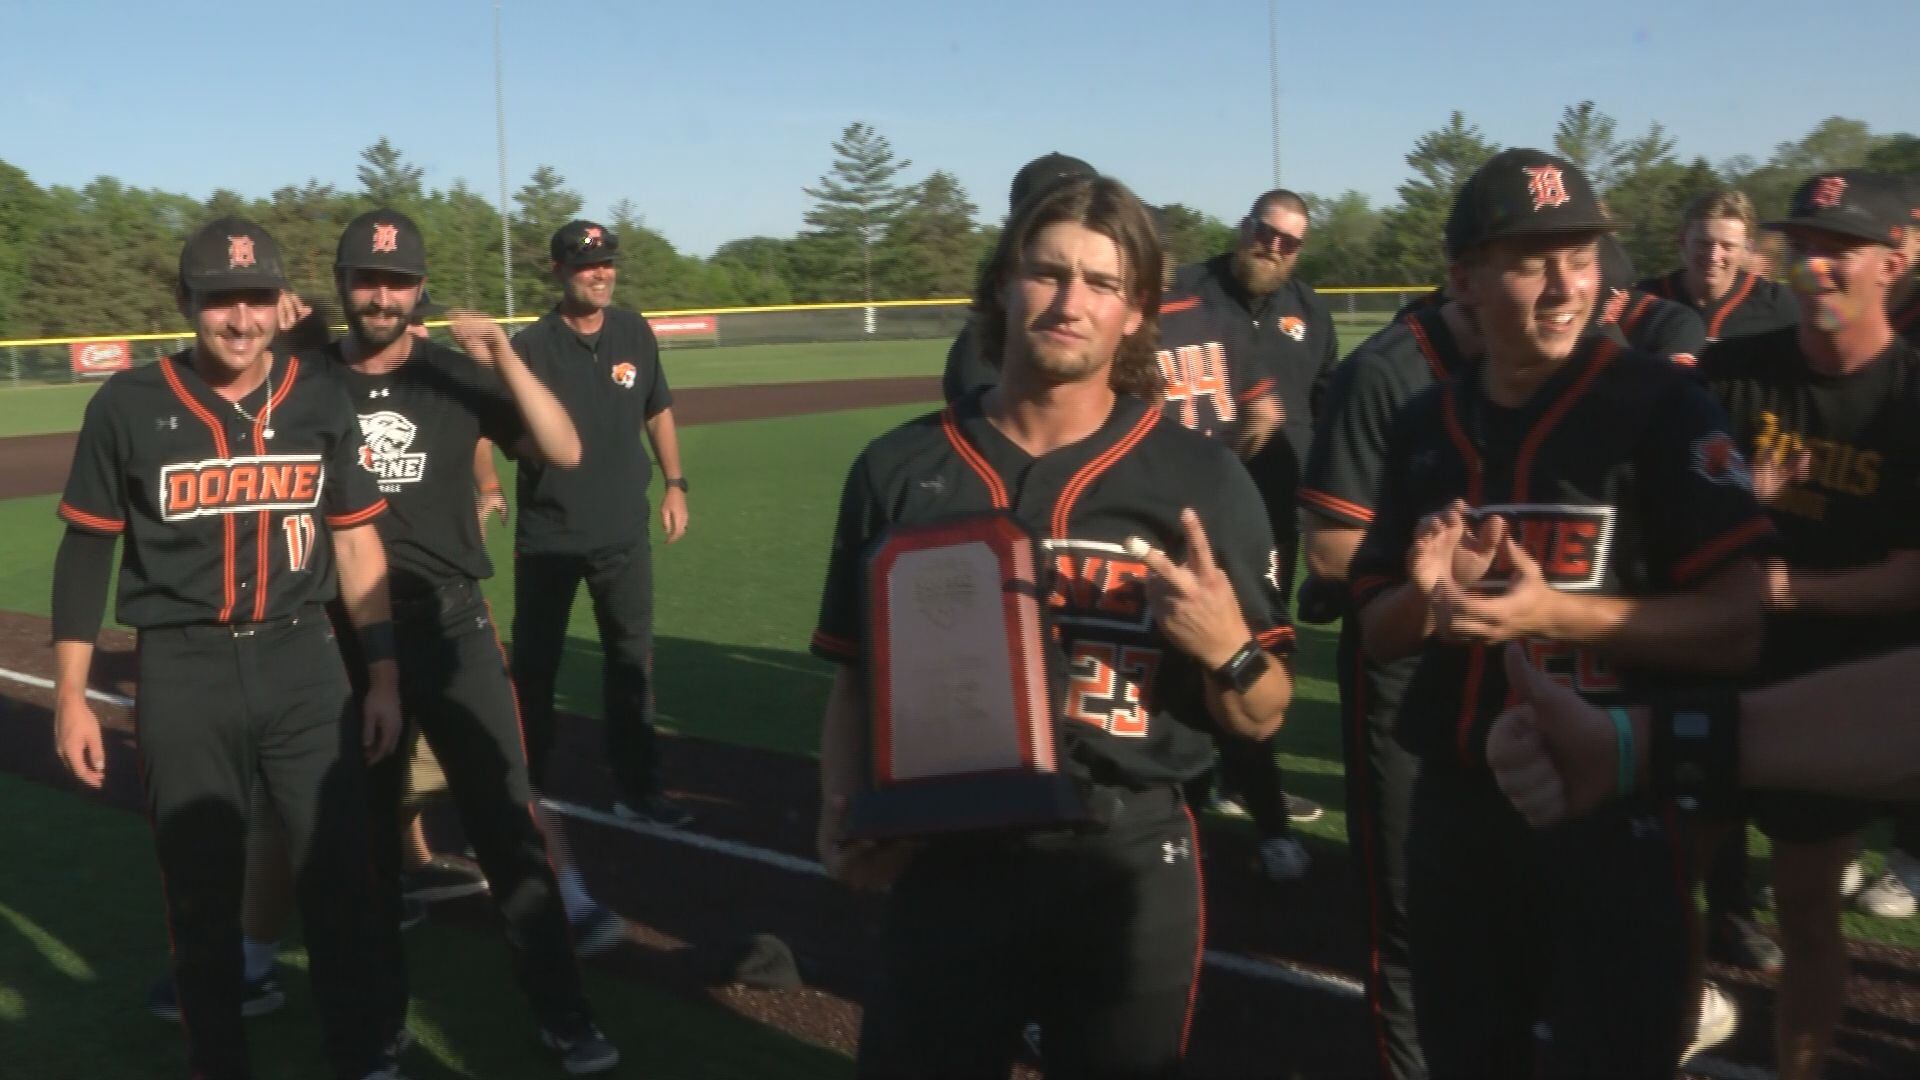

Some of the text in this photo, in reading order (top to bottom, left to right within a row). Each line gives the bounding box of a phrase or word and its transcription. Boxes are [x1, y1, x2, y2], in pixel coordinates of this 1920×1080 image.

[1155, 342, 1237, 429] 44
[168, 463, 319, 511] DOANE
[1065, 640, 1162, 738] 23
